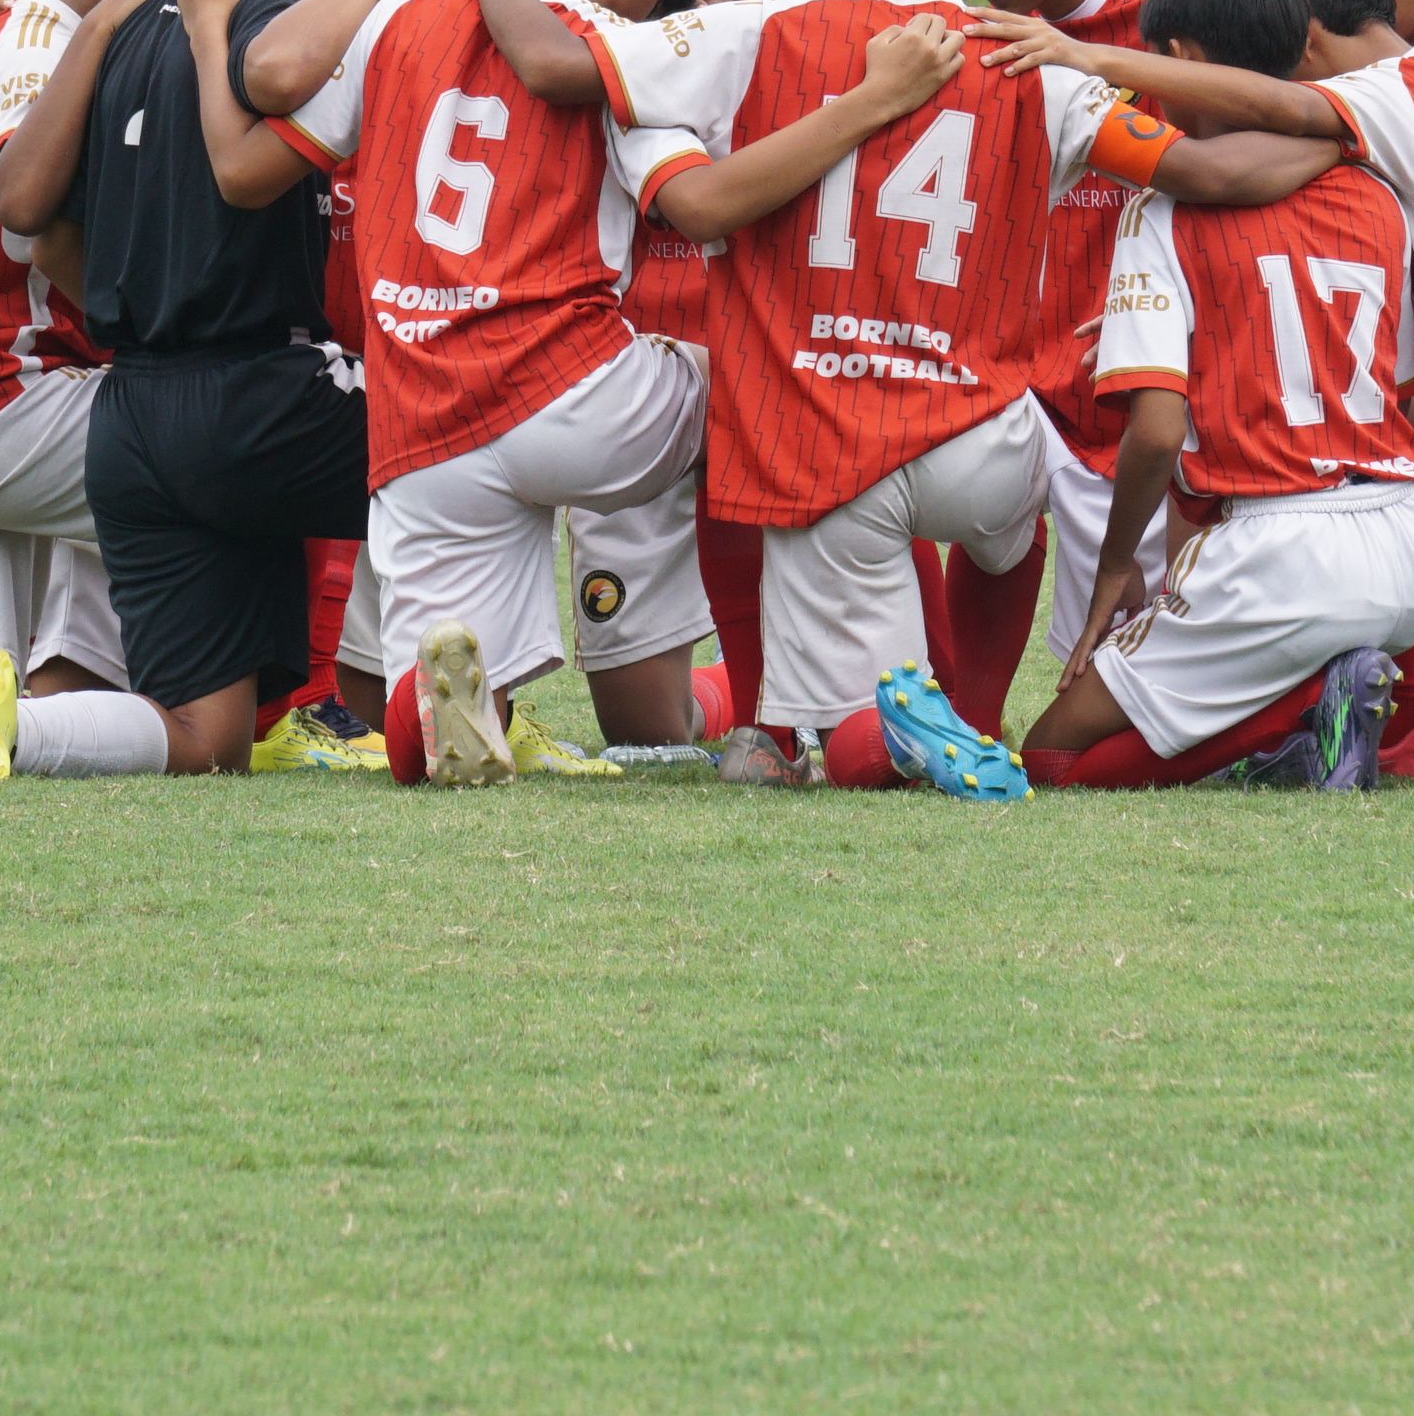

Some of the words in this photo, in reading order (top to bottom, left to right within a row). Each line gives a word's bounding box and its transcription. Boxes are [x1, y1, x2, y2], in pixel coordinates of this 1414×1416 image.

[415, 87, 509, 256] 6
[808, 94, 977, 288] 14
[371, 278, 500, 311] BORNEO
[810, 314, 952, 355] BORNEO
[1257, 255, 1386, 426] 17
[792, 350, 979, 385] FOOTBALL
